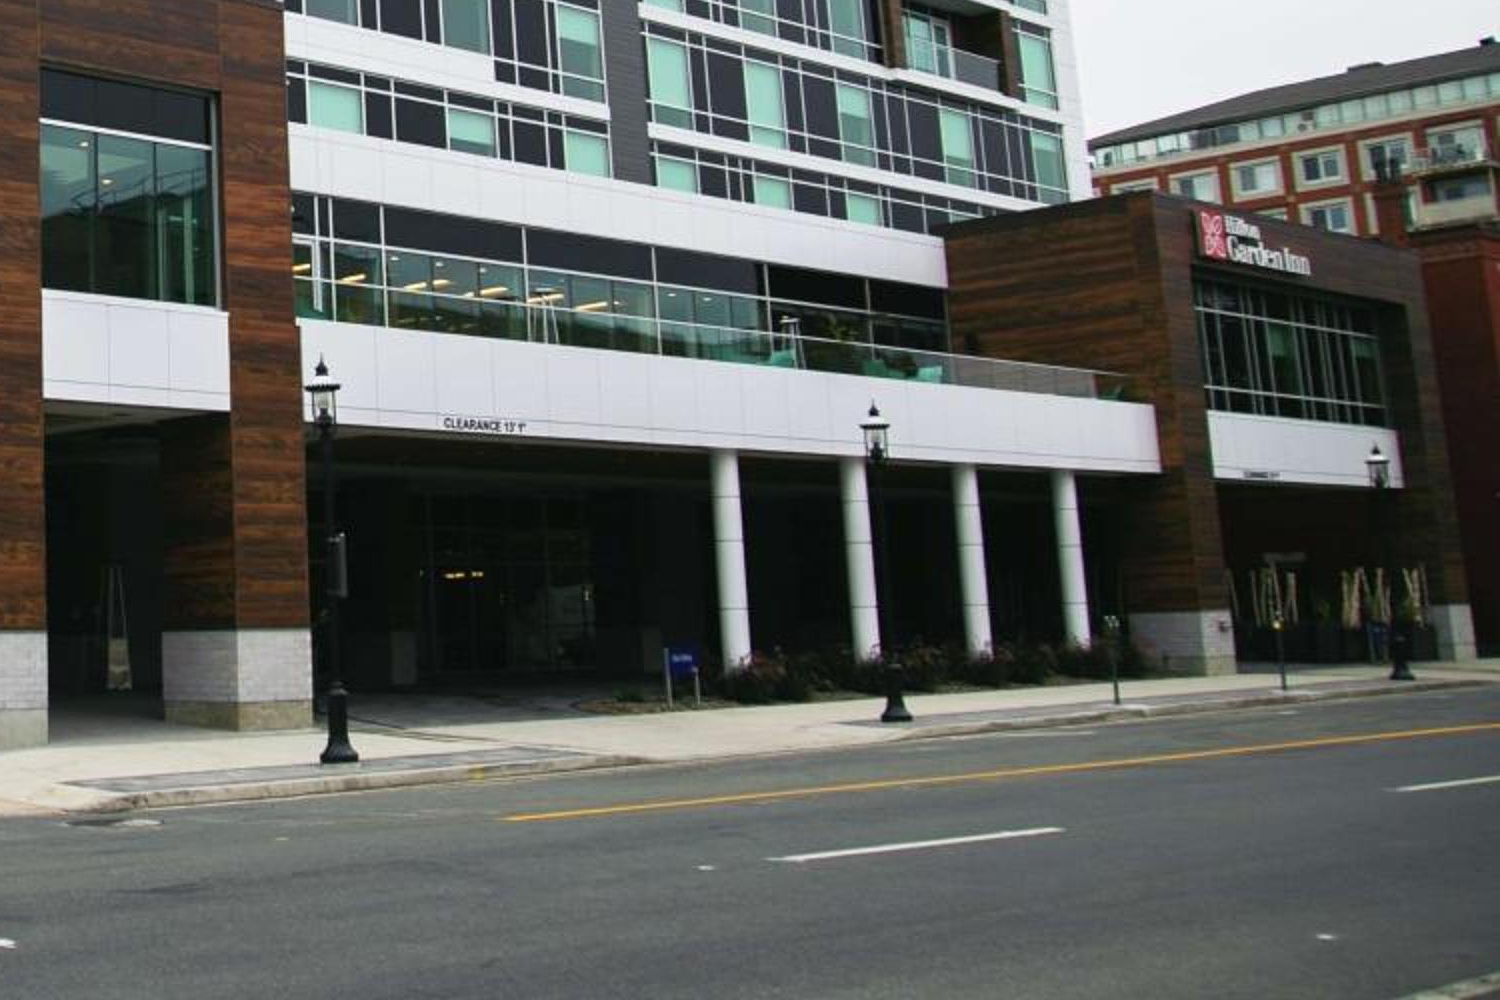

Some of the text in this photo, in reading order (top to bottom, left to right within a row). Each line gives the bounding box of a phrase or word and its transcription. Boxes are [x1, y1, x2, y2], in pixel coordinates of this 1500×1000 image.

[1227, 236, 1311, 275] Garden Inn
[443, 417, 502, 431] CLEARANCE
